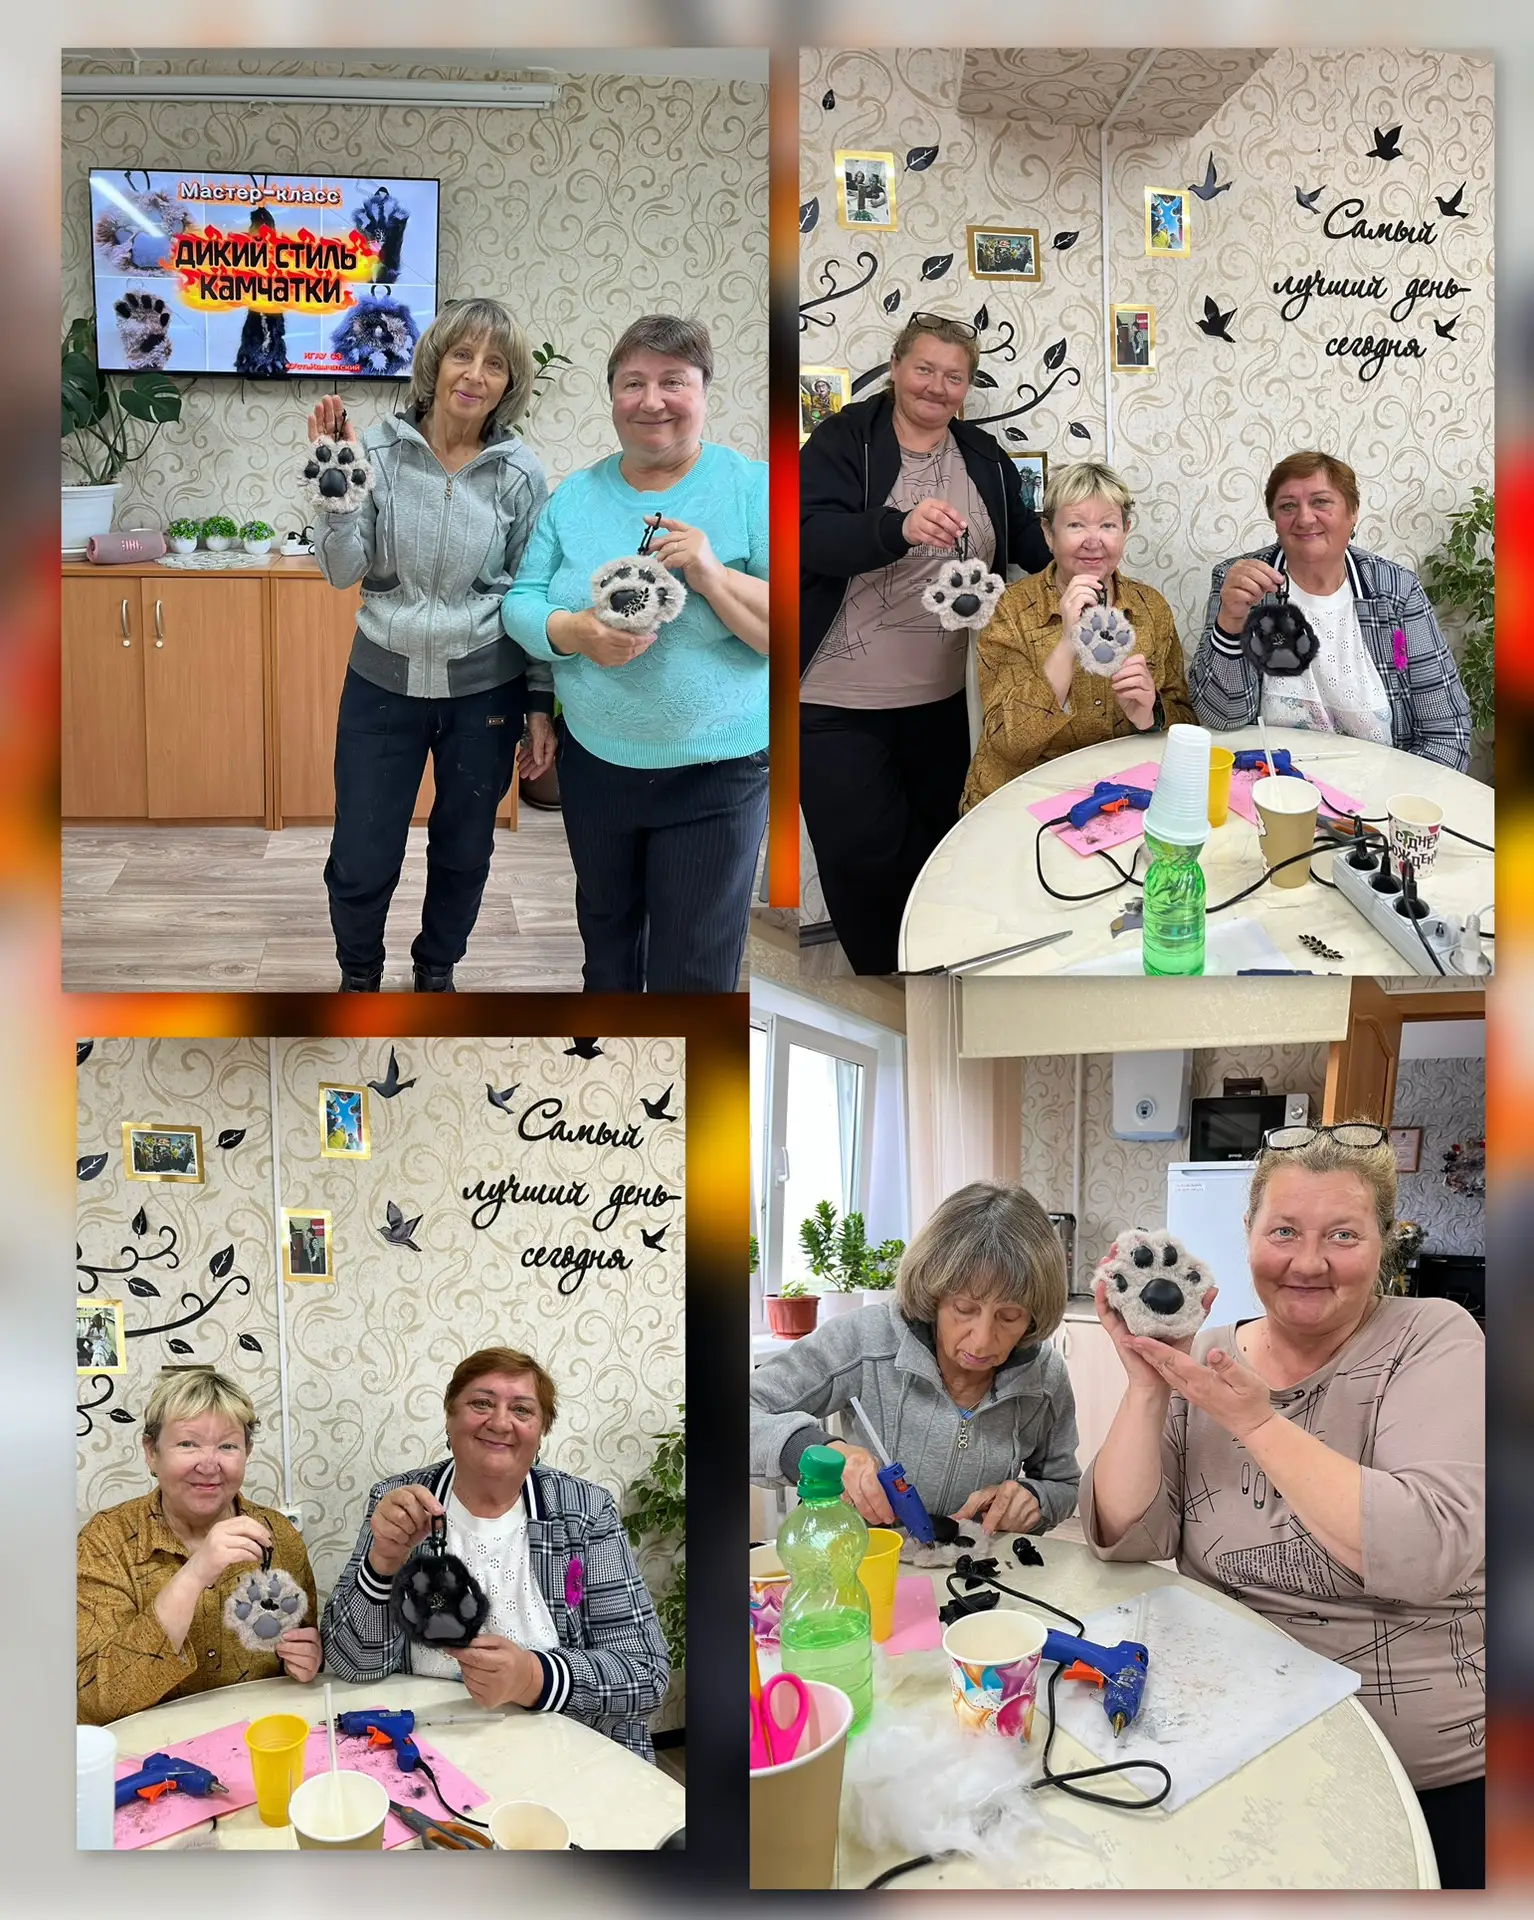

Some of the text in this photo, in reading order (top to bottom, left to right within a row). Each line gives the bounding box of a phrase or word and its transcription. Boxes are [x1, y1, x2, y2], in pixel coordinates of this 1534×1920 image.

[180, 182, 341, 204] Мастер-класс
[1323, 198, 1438, 245] Самый
[175, 236, 357, 271] ДИКИЙ СТИЛЬ
[1273, 270, 1472, 323] лучший день
[1325, 335, 1427, 382] сегодня
[121, 539, 143, 551] JBL
[518, 1097, 645, 1149] Самый
[462, 1174, 682, 1232] лучший день
[520, 1245, 634, 1296] сегодня
